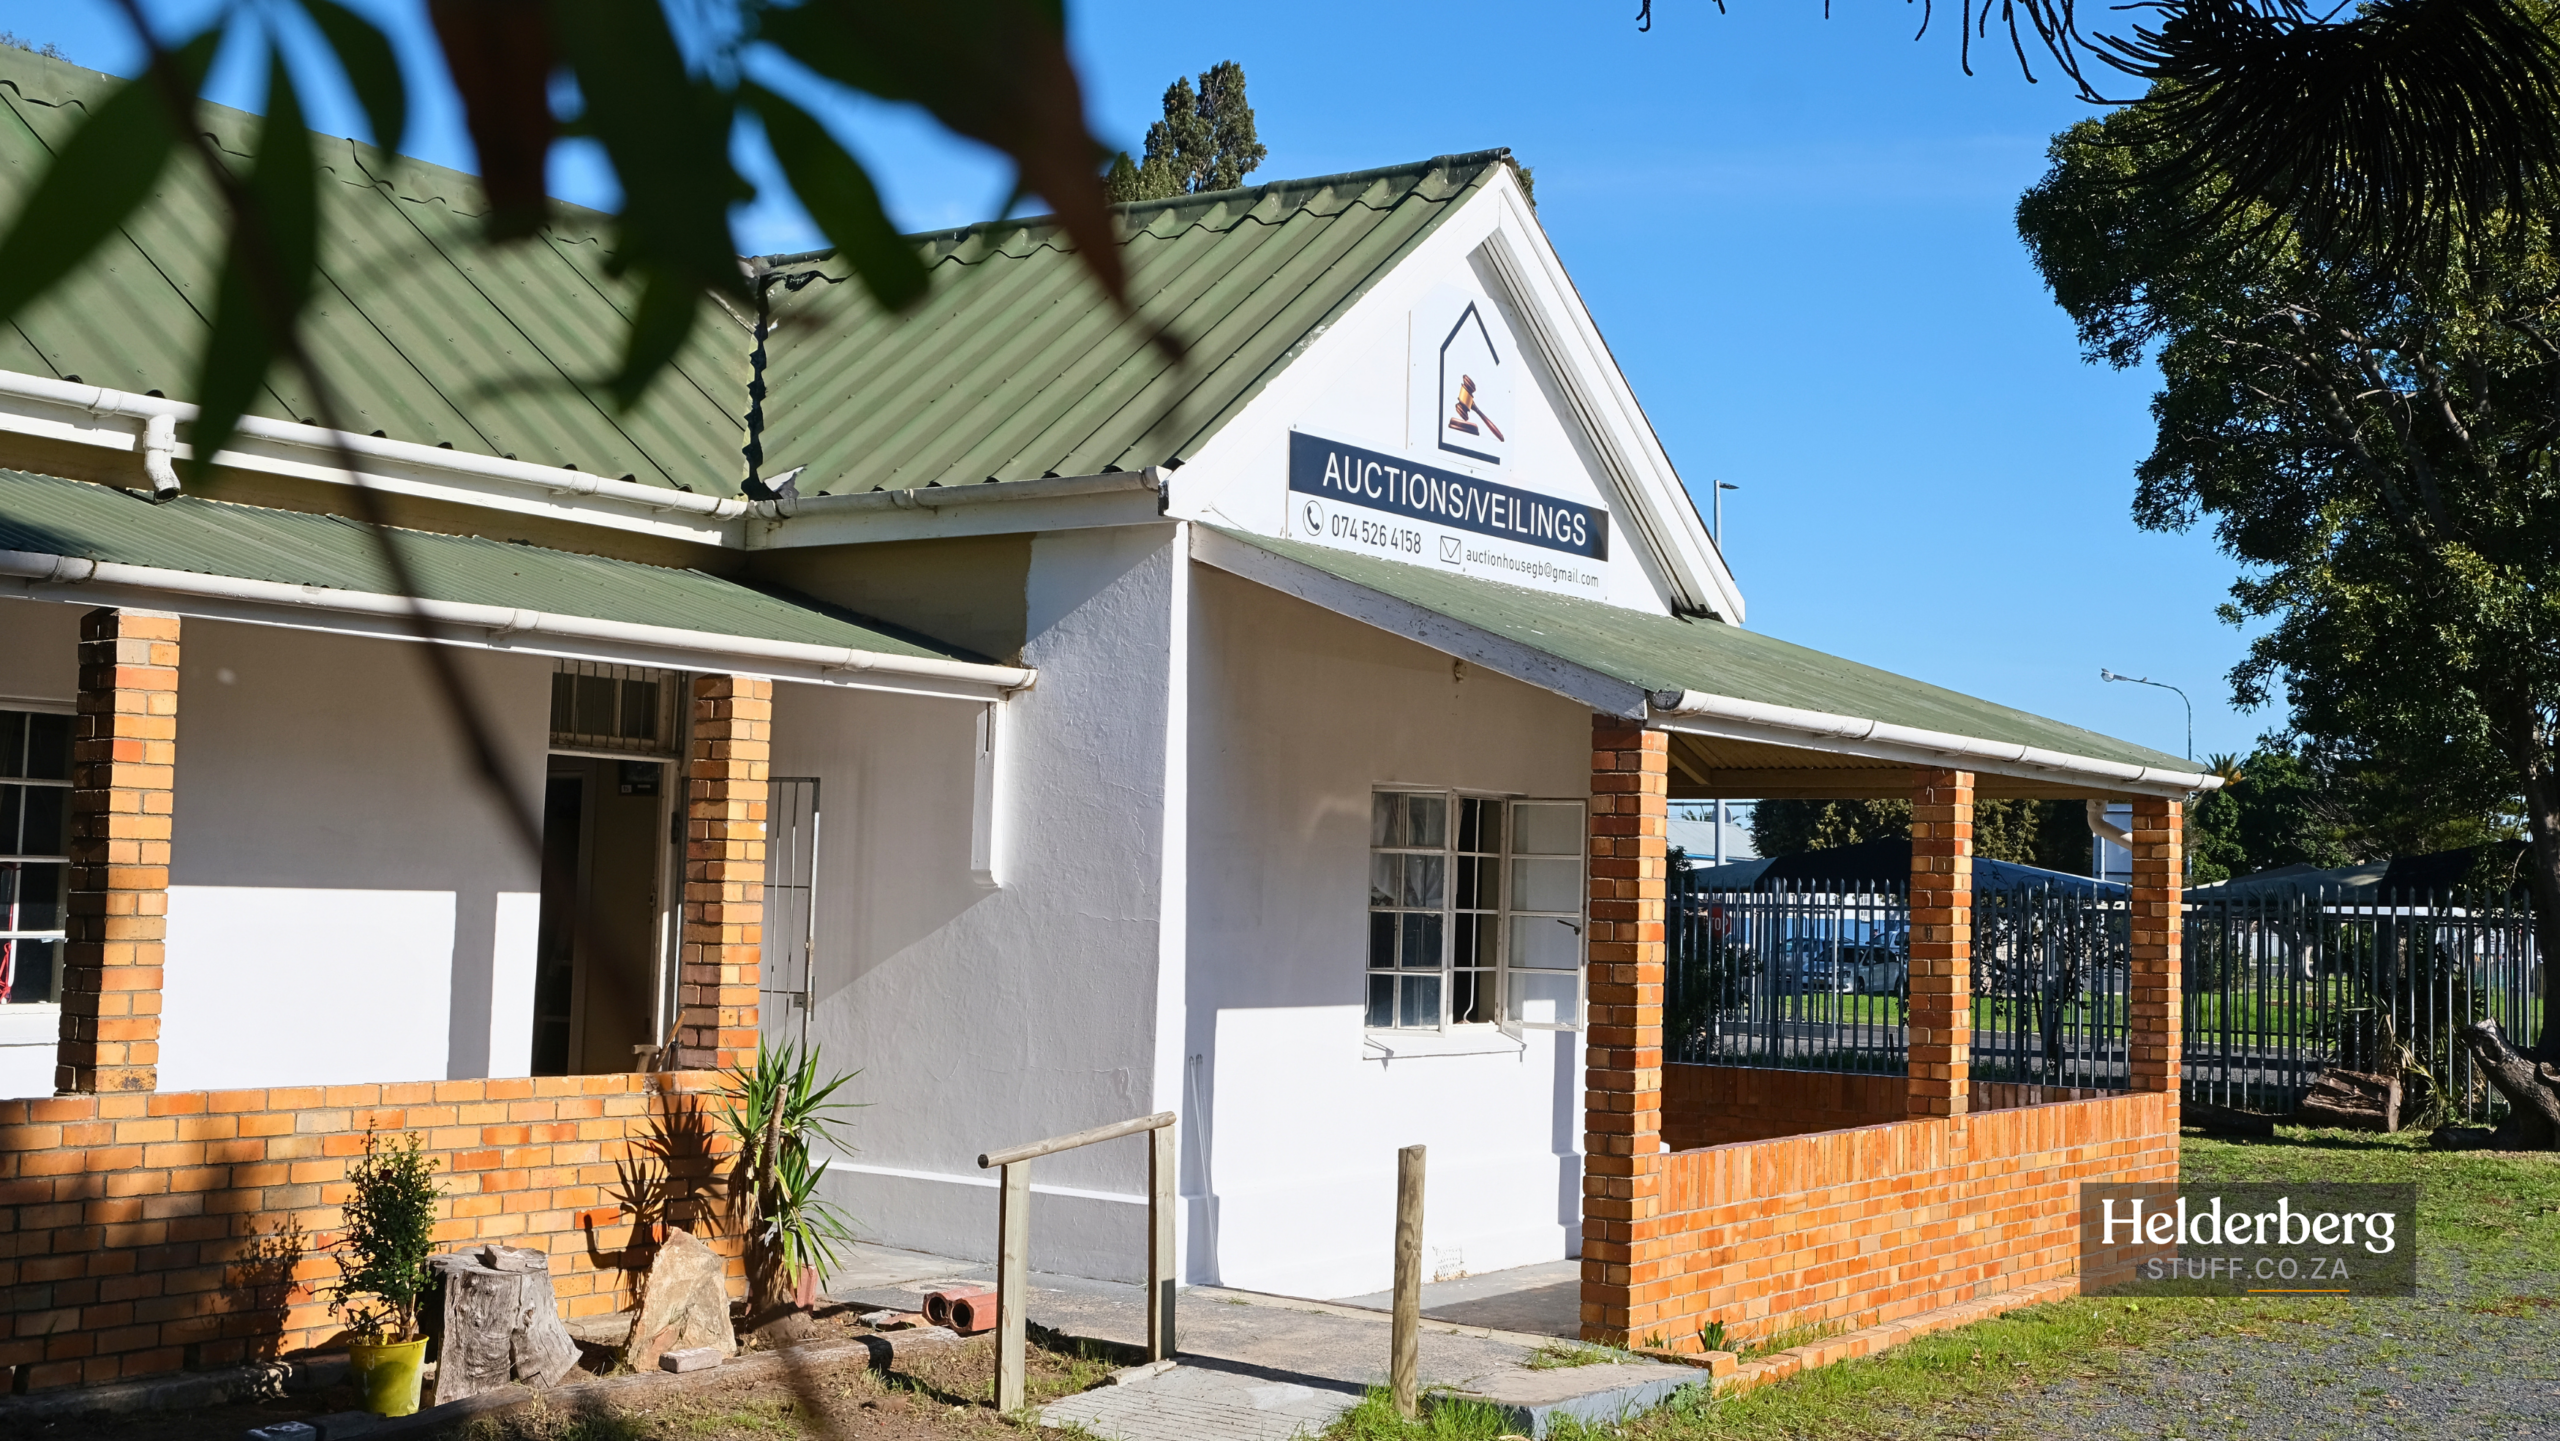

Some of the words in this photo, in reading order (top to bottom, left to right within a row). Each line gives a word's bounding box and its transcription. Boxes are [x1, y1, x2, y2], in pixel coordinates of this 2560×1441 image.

[1322, 452, 1587, 546] AUCTIONS/VEILINGS
[1331, 514, 1358, 541] 074
[1362, 520, 1387, 547] 526
[1390, 528, 1422, 554] 4158
[1466, 549, 1599, 588] auctionhousegb@gmail.com
